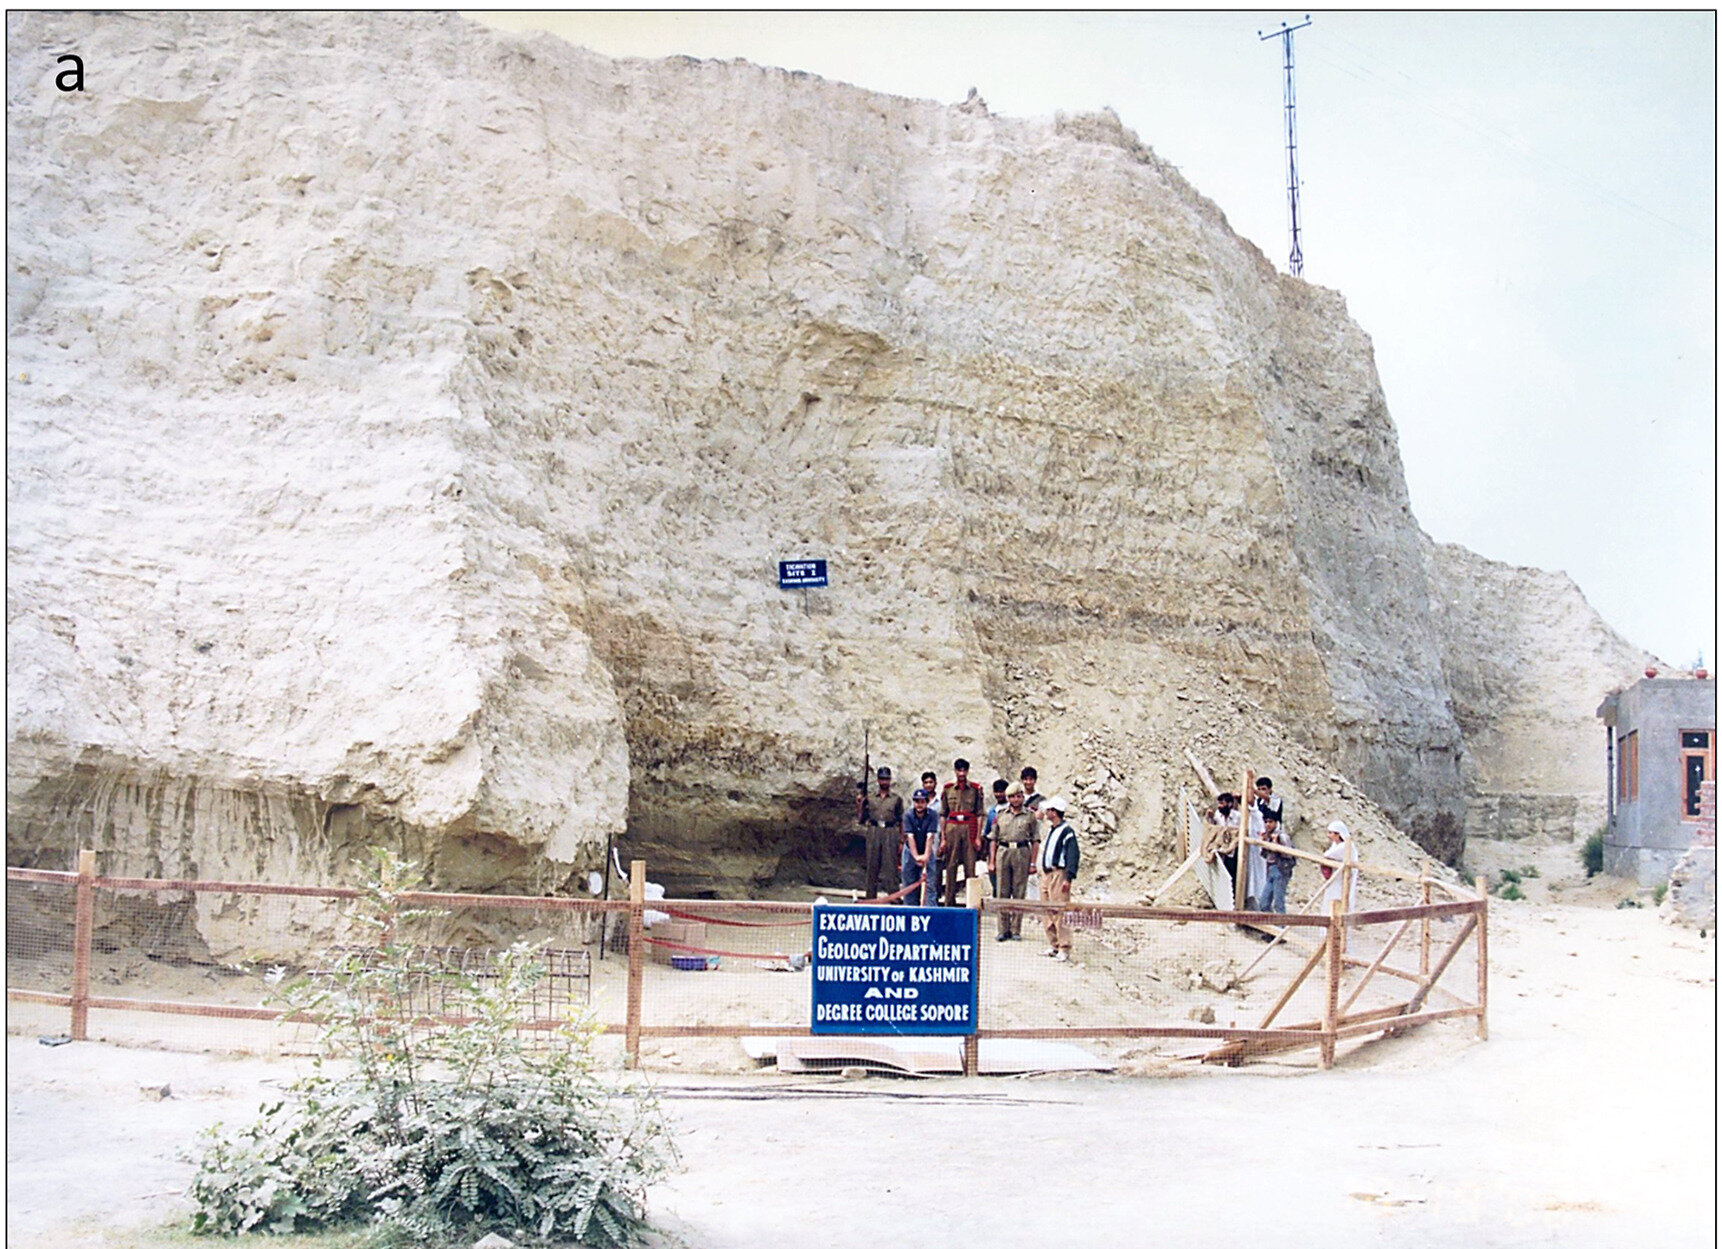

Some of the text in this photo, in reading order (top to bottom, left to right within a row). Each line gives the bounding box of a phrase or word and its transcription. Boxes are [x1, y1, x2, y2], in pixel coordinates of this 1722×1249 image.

[820, 913, 931, 932] EXCAVATION BY
[818, 935, 971, 961] GEOLOGY DEPARTMENT
[817, 966, 891, 982] UNIVERSITY
[909, 966, 970, 983] KASHMIR
[864, 987, 919, 999] AND
[817, 1003, 969, 1022] DEGREE COLLEGE SOPORE
